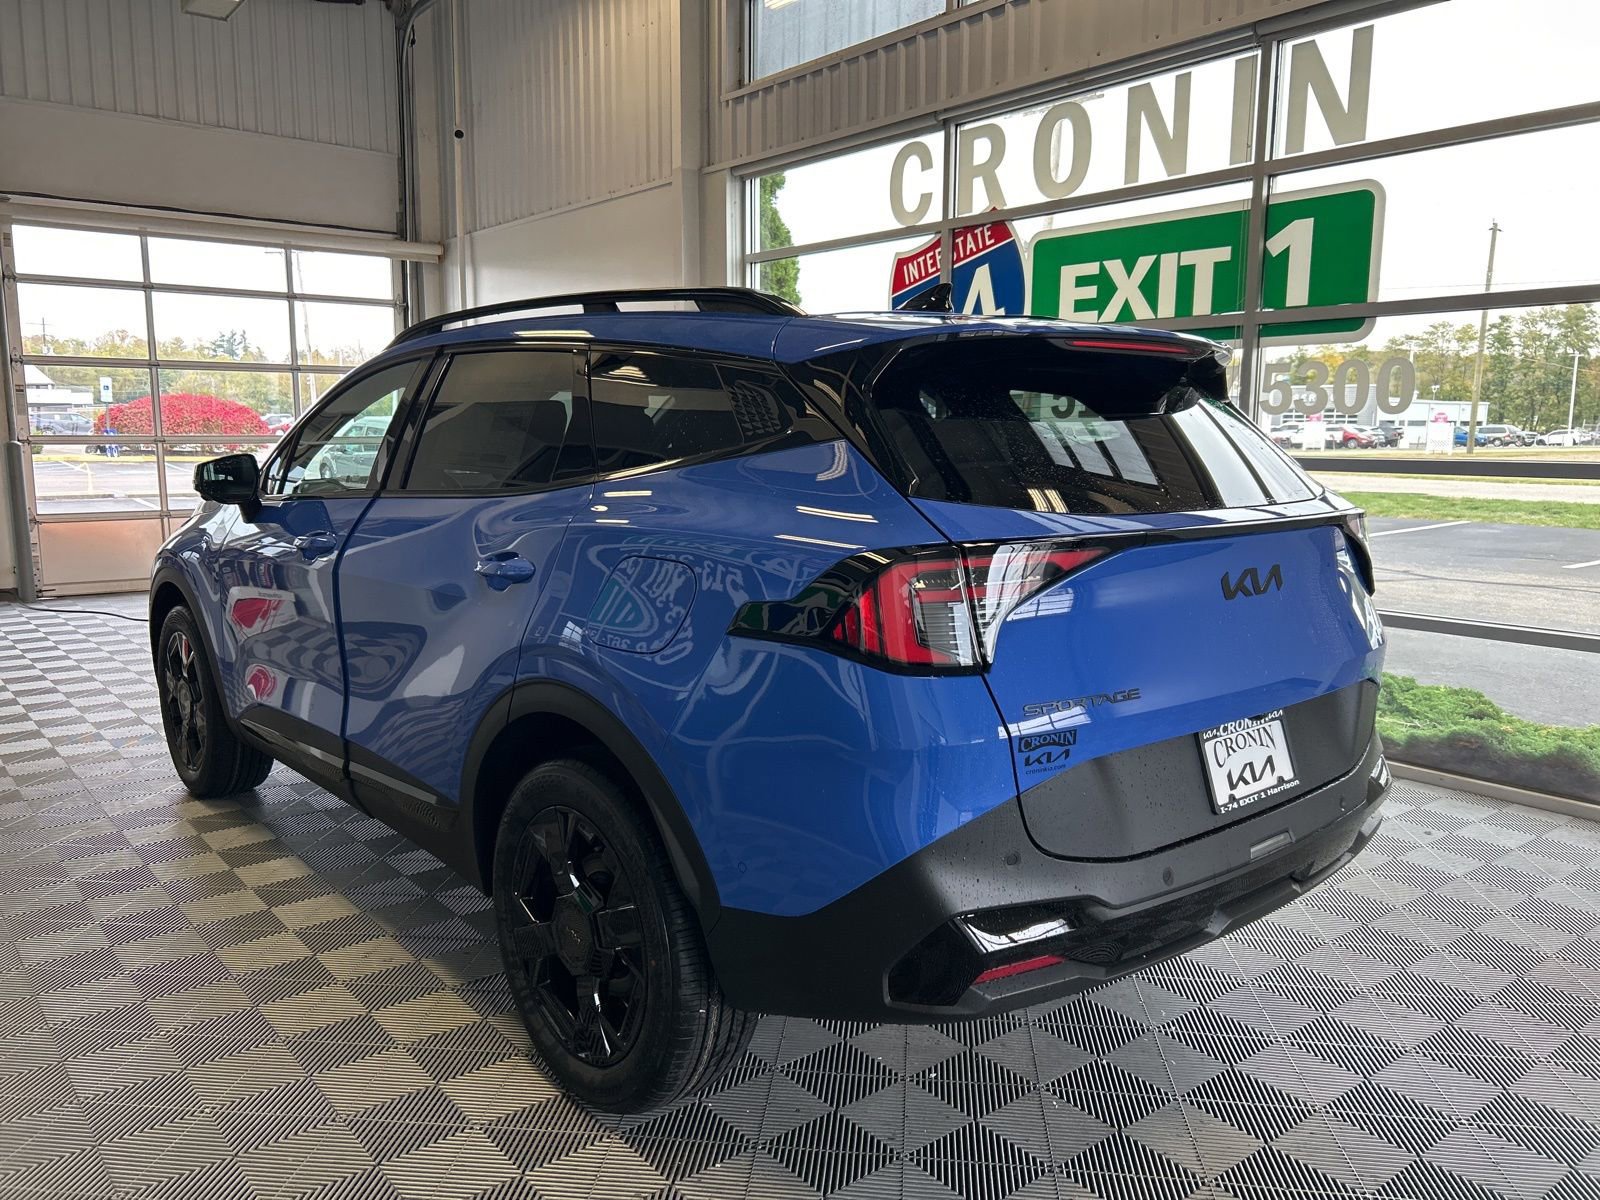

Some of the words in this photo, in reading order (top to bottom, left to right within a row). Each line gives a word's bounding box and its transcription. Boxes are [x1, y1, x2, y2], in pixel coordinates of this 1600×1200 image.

[890, 24, 1374, 226] CRONIN
[1059, 246, 1232, 323] EXIT
[1266, 218, 1314, 307] 1
[1260, 357, 1415, 415] 5300
[1221, 564, 1283, 600] KIA
[1023, 688, 1142, 717] SPORTAGE
[1021, 731, 1076, 752] CRONIN
[1024, 749, 1070, 766] KIA
[1213, 725, 1276, 768] CRONIN
[1226, 755, 1276, 791] KIA
[1220, 801, 1239, 814] I-74
[1239, 793, 1259, 806] EXIT
[1267, 779, 1300, 796] Harrison
